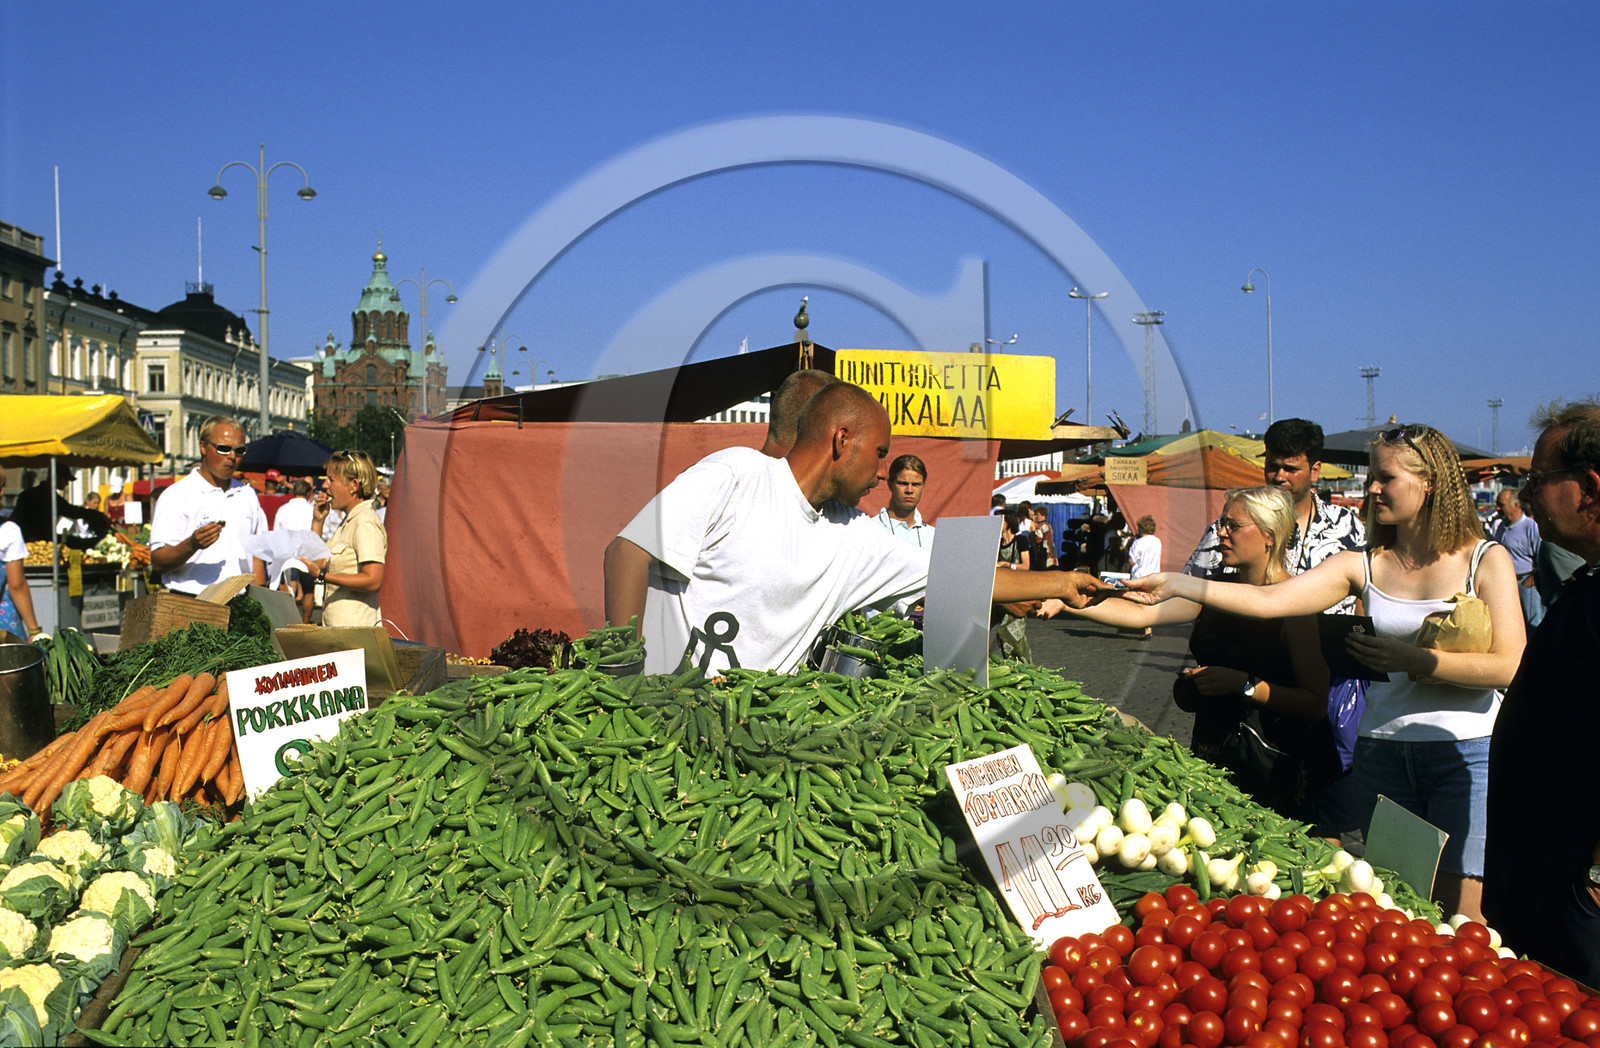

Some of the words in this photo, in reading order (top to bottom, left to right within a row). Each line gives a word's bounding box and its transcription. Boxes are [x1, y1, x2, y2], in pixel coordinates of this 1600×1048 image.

[880, 392, 986, 430] UKALAA
[1112, 472, 1139, 481] SIIKAA
[255, 662, 338, 695] KOTIMAINEN
[236, 686, 366, 737] PORKKANA
[956, 754, 1023, 791] KOTIMAINEN
[965, 773, 1055, 827] TOMAATTI
[1077, 884, 1102, 907] KG
